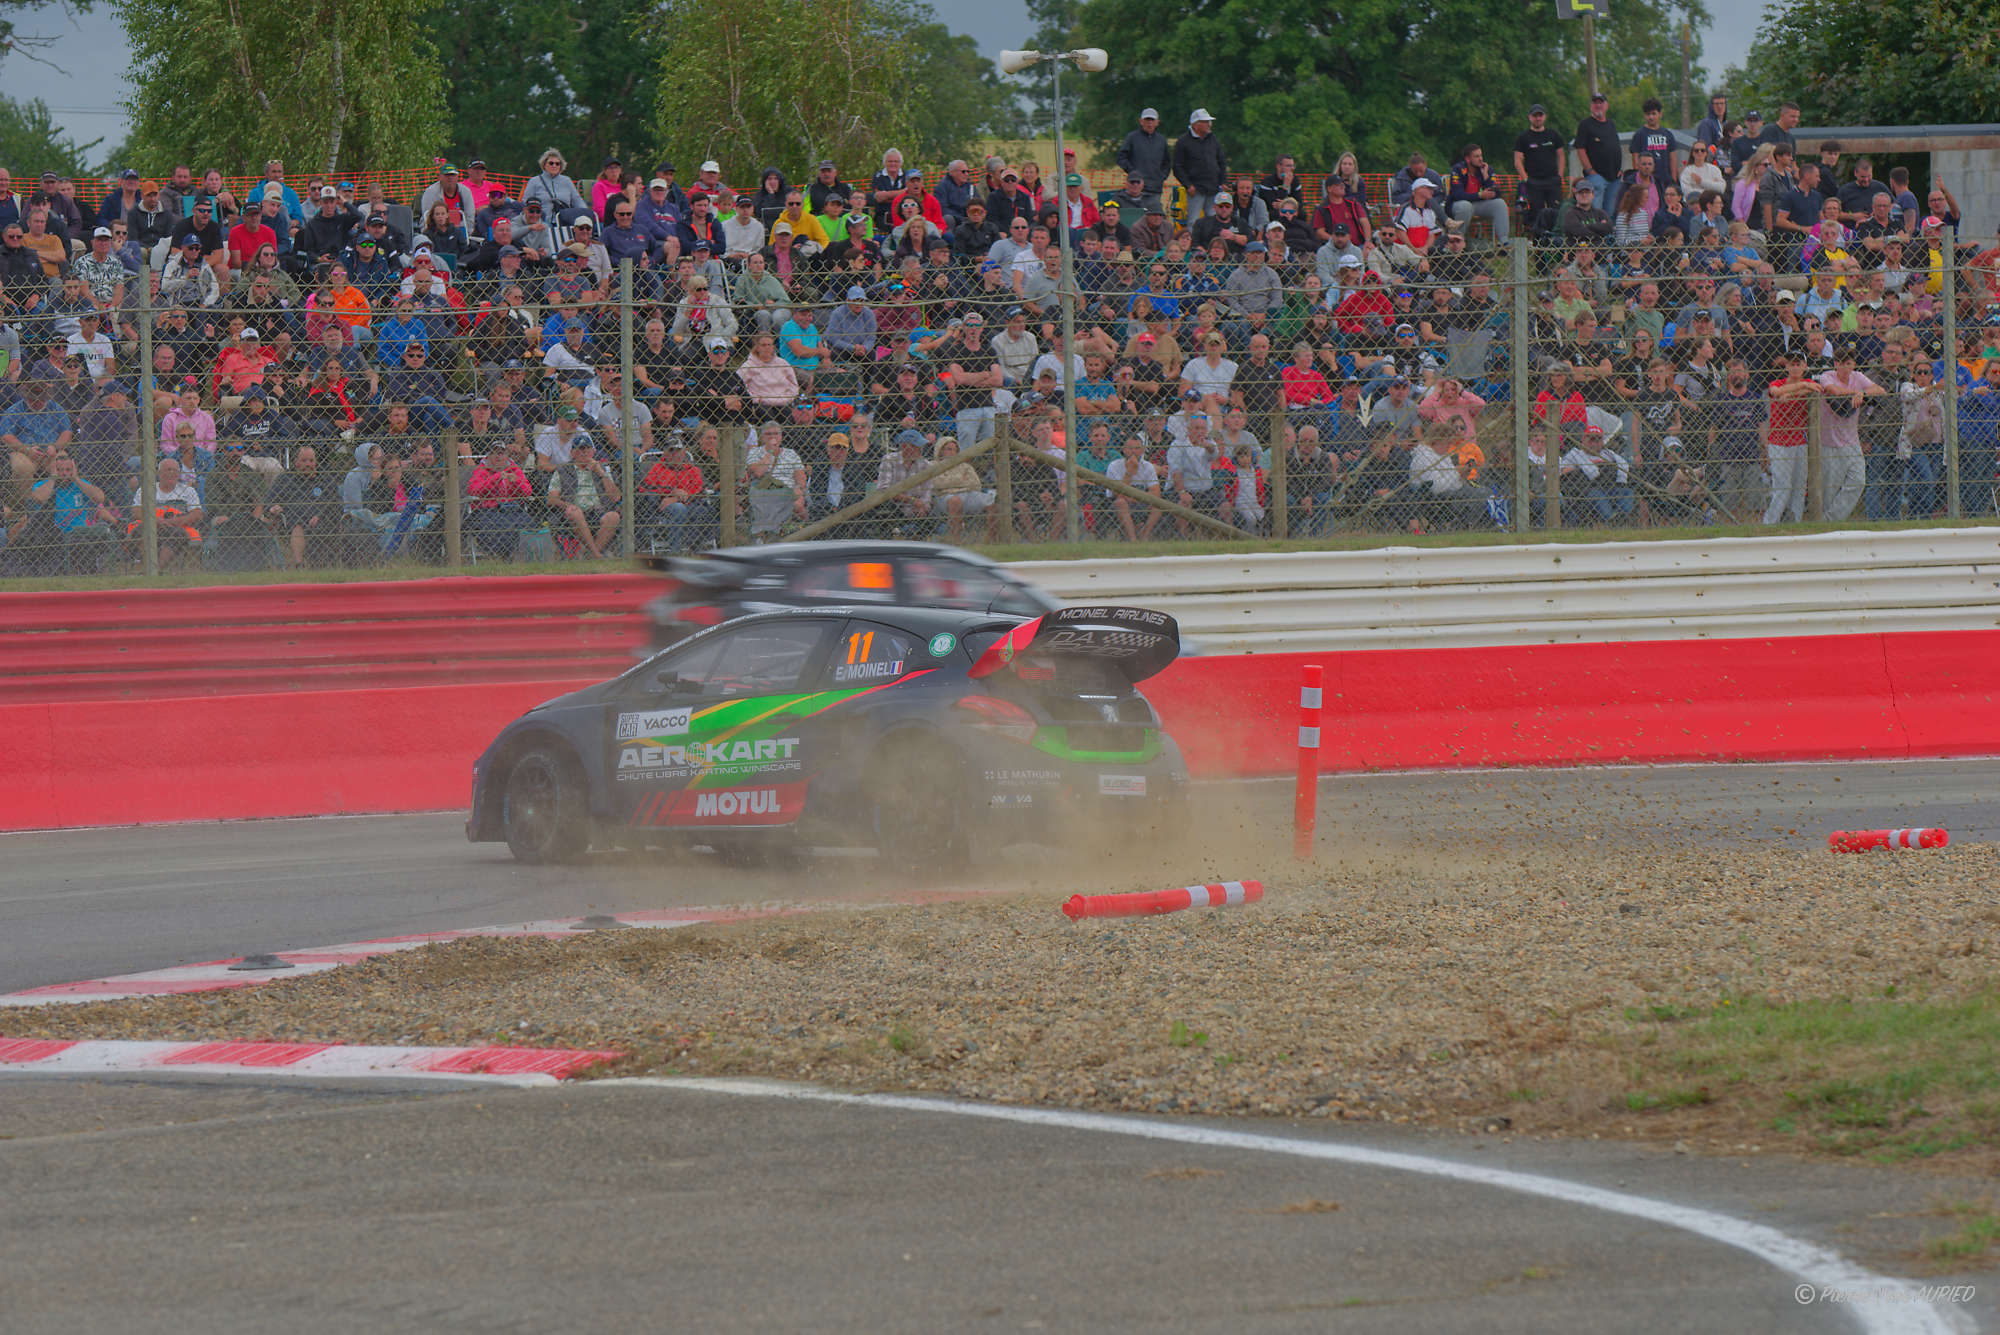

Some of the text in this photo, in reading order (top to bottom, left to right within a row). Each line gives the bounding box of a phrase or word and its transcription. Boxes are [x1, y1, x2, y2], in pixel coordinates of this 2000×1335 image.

[1058, 608, 1168, 626] MOINEL AIRLINES
[847, 631, 874, 665] 11
[848, 661, 889, 680] MOINEL
[643, 715, 688, 730] YACCO
[616, 762, 801, 781] CHUTE LIBRE KARTING WINSCAPE
[695, 790, 782, 817] MOTUL
